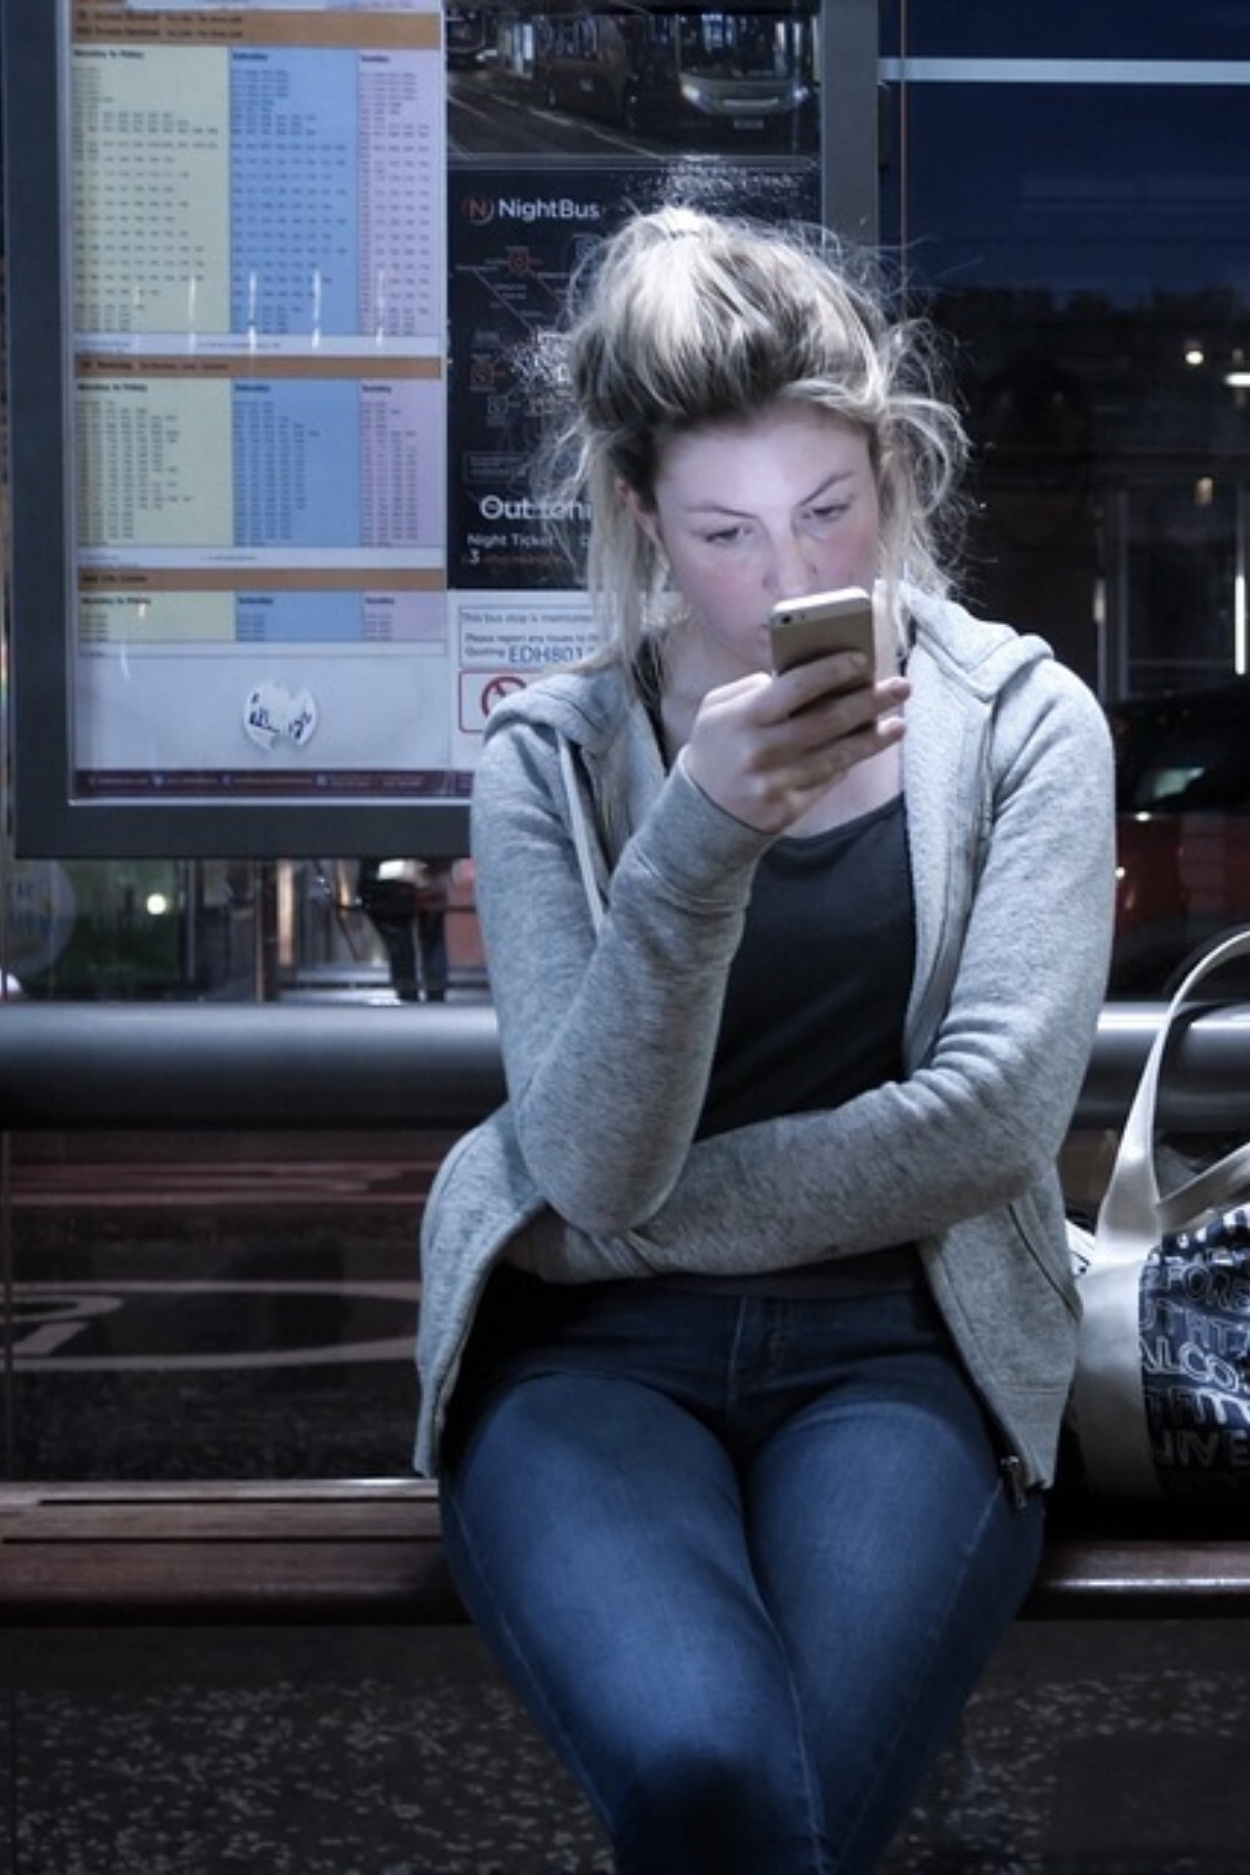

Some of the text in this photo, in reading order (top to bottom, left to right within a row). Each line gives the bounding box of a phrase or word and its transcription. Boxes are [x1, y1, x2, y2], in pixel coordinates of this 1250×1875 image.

[499, 198, 600, 222] NightBus
[480, 494, 534, 520] Out
[467, 533, 507, 549] Night
